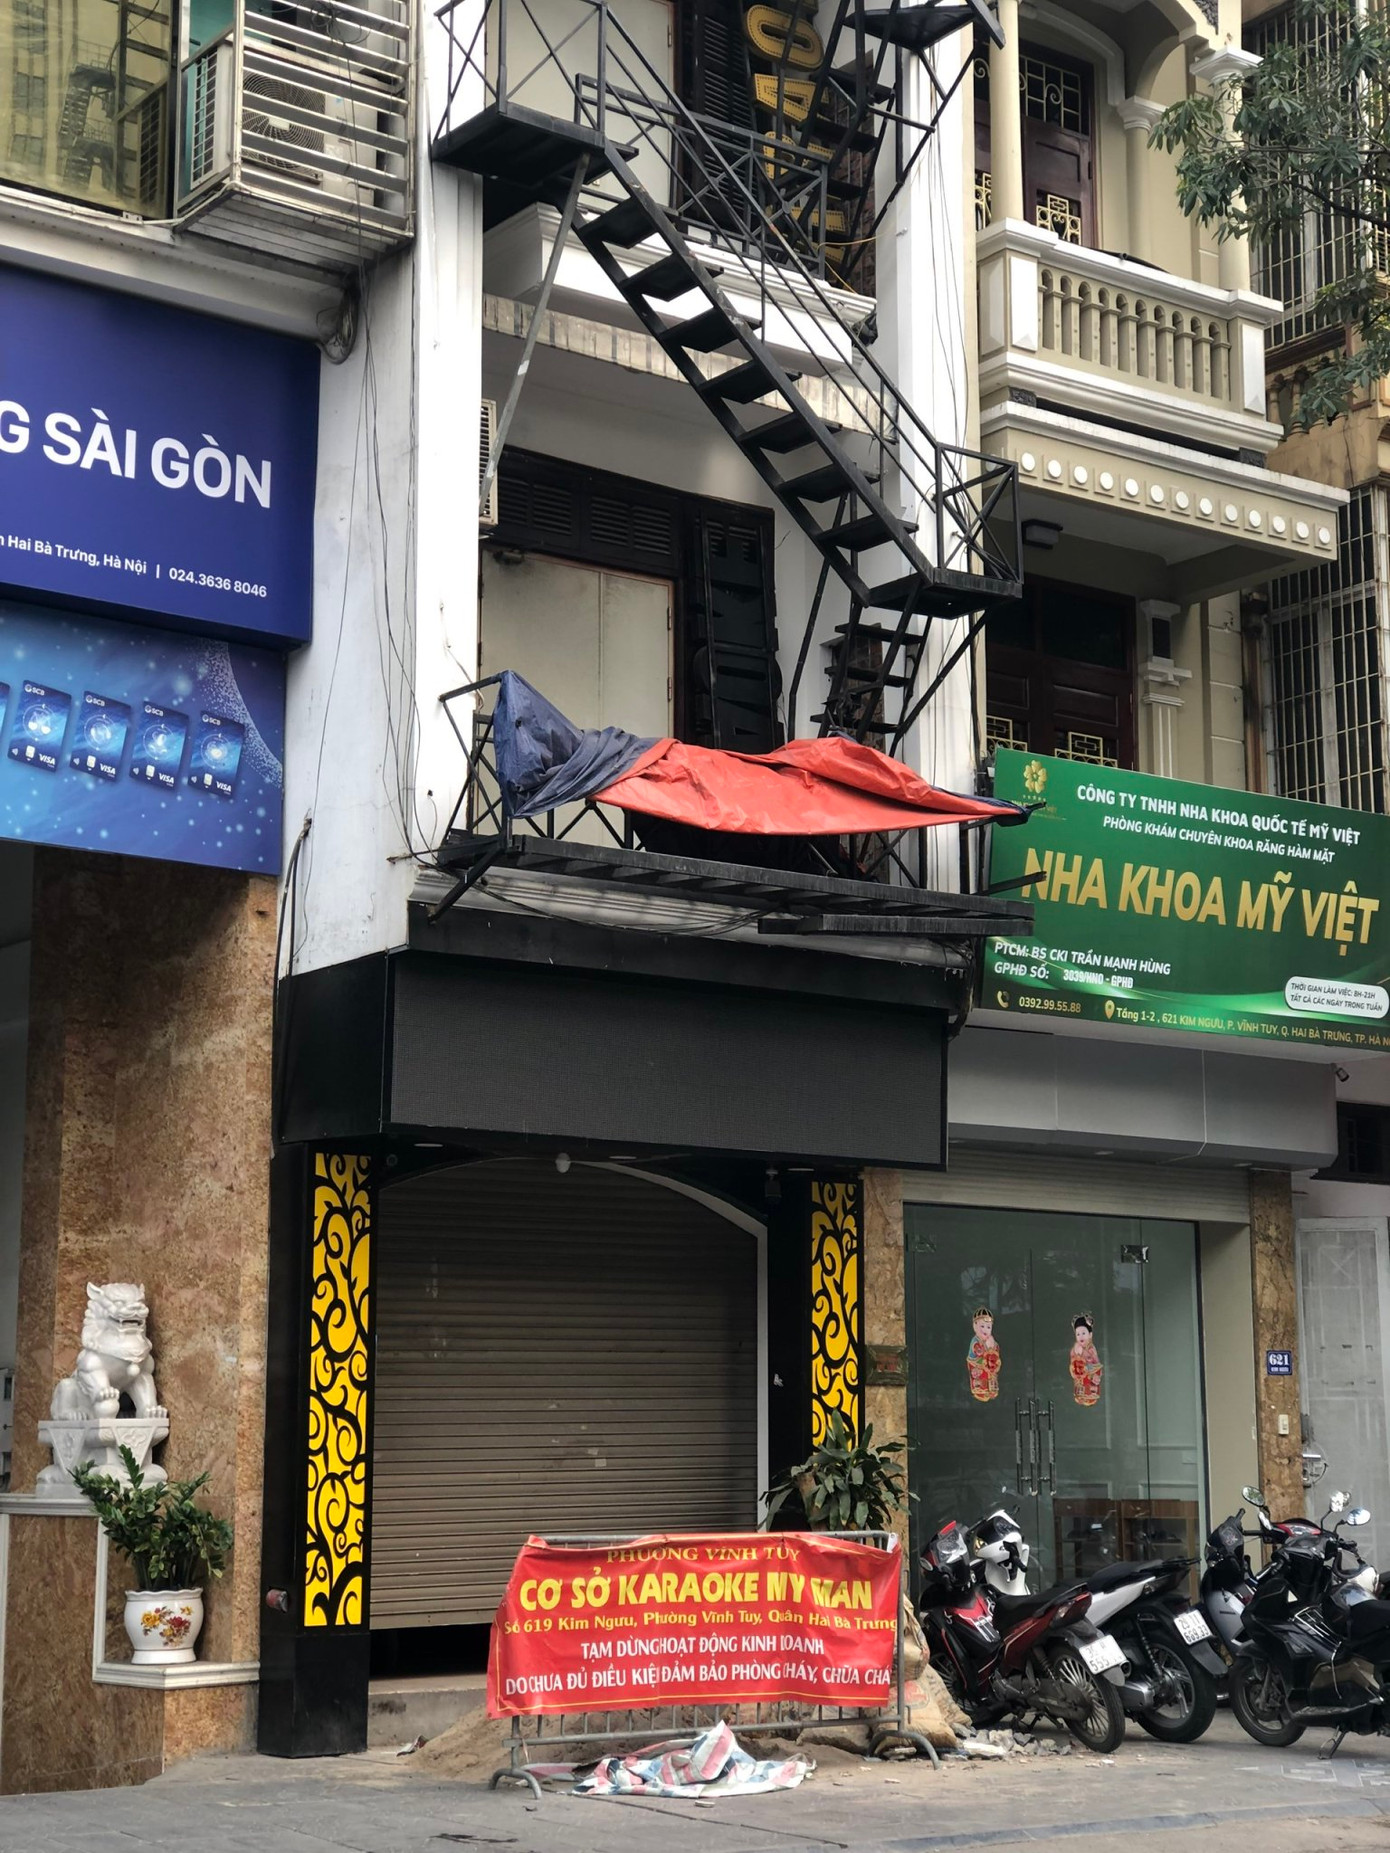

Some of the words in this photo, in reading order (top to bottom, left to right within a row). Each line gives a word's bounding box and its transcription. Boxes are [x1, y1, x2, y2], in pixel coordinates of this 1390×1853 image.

[43, 407, 137, 479] SÀI
[151, 433, 272, 509] GÒN
[8, 535, 31, 551] Hai
[34, 540, 52, 555] Bà
[55, 544, 100, 567] Trưng,
[103, 554, 121, 569] Hà
[124, 558, 147, 575] Nội
[169, 567, 231, 590] 024.3636
[233, 580, 267, 598] 8046
[39, 753, 56, 765] VISA
[100, 763, 116, 775] VISA
[159, 772, 175, 784] VISA
[216, 781, 232, 792] VISA
[1077, 783, 1115, 805] CÔNG
[1119, 792, 1137, 809] TY
[1140, 796, 1176, 815] TNHH
[1180, 803, 1208, 821] NHA
[1211, 808, 1248, 827] KHOA
[1252, 814, 1288, 834] QUỐC
[1291, 819, 1308, 837] TẾ
[1309, 823, 1329, 840] MỸ
[1332, 827, 1360, 847] VIỆT
[1103, 815, 1142, 833] PHÒNG
[1144, 823, 1177, 839] KHÁM
[1179, 828, 1222, 846] CHUYÊN
[1224, 835, 1254, 851] KHOA
[1256, 839, 1285, 855] RĂNG
[1287, 844, 1311, 860] HÀM
[1313, 848, 1336, 865] MẶT
[1021, 847, 1108, 909] NHA
[1118, 862, 1226, 926] KHOA
[1236, 871, 1295, 933] MỸ
[1302, 881, 1380, 957] VIỆT
[994, 942, 1030, 958] PTCM:
[1031, 946, 1047, 960] BS
[1049, 949, 1068, 962] CKI
[1103, 955, 1137, 972] MẠNH
[1139, 958, 1171, 975] HÙNG
[994, 962, 1028, 976] GPHĐ
[1029, 962, 1050, 980] SỐ:
[1307, 984, 1322, 993] GIAN
[1323, 985, 1337, 995] LÀM
[1018, 996, 1082, 1013] 0392.99.55.88
[1344, 1001, 1365, 1010] TRONG
[1141, 1011, 1155, 1022] 1-2
[1162, 1013, 1177, 1024] 621
[1179, 1015, 1196, 1026] KIM
[1227, 1020, 1235, 1031] P.
[1260, 1023, 1280, 1036] TUY,
[1281, 1026, 1289, 1037] Q.
[1291, 1028, 1307, 1038] HAI
[1308, 1027, 1320, 1039] BÀ
[1369, 1032, 1380, 1046] HÀ
[1269, 1353, 1290, 1366] 621
[520, 1578, 563, 1611] CƠ
[571, 1566, 612, 1609] SỞ
[618, 1572, 760, 1606] KARAOKE
[766, 1571, 806, 1603] MY
[810, 1577, 873, 1610] MAN
[523, 1618, 553, 1633] 619
[558, 1617, 589, 1631] Kim
[702, 1610, 734, 1624] Vĩnh
[738, 1610, 763, 1626] Tuy,
[809, 1612, 831, 1628] Hai
[834, 1615, 852, 1630] Bà
[580, 1642, 613, 1664] TẠM
[699, 1632, 738, 1657] ĐỘNG
[741, 1635, 777, 1653] KINH
[505, 1678, 528, 1696] DO
[566, 1667, 588, 1690] ĐỦ
[592, 1663, 627, 1689] ĐIỀU
[662, 1660, 695, 1683] ĐẢM
[699, 1659, 728, 1682] BẢO
[731, 1659, 781, 1681] PHÒNG
[822, 1664, 860, 1685] CHỮA
